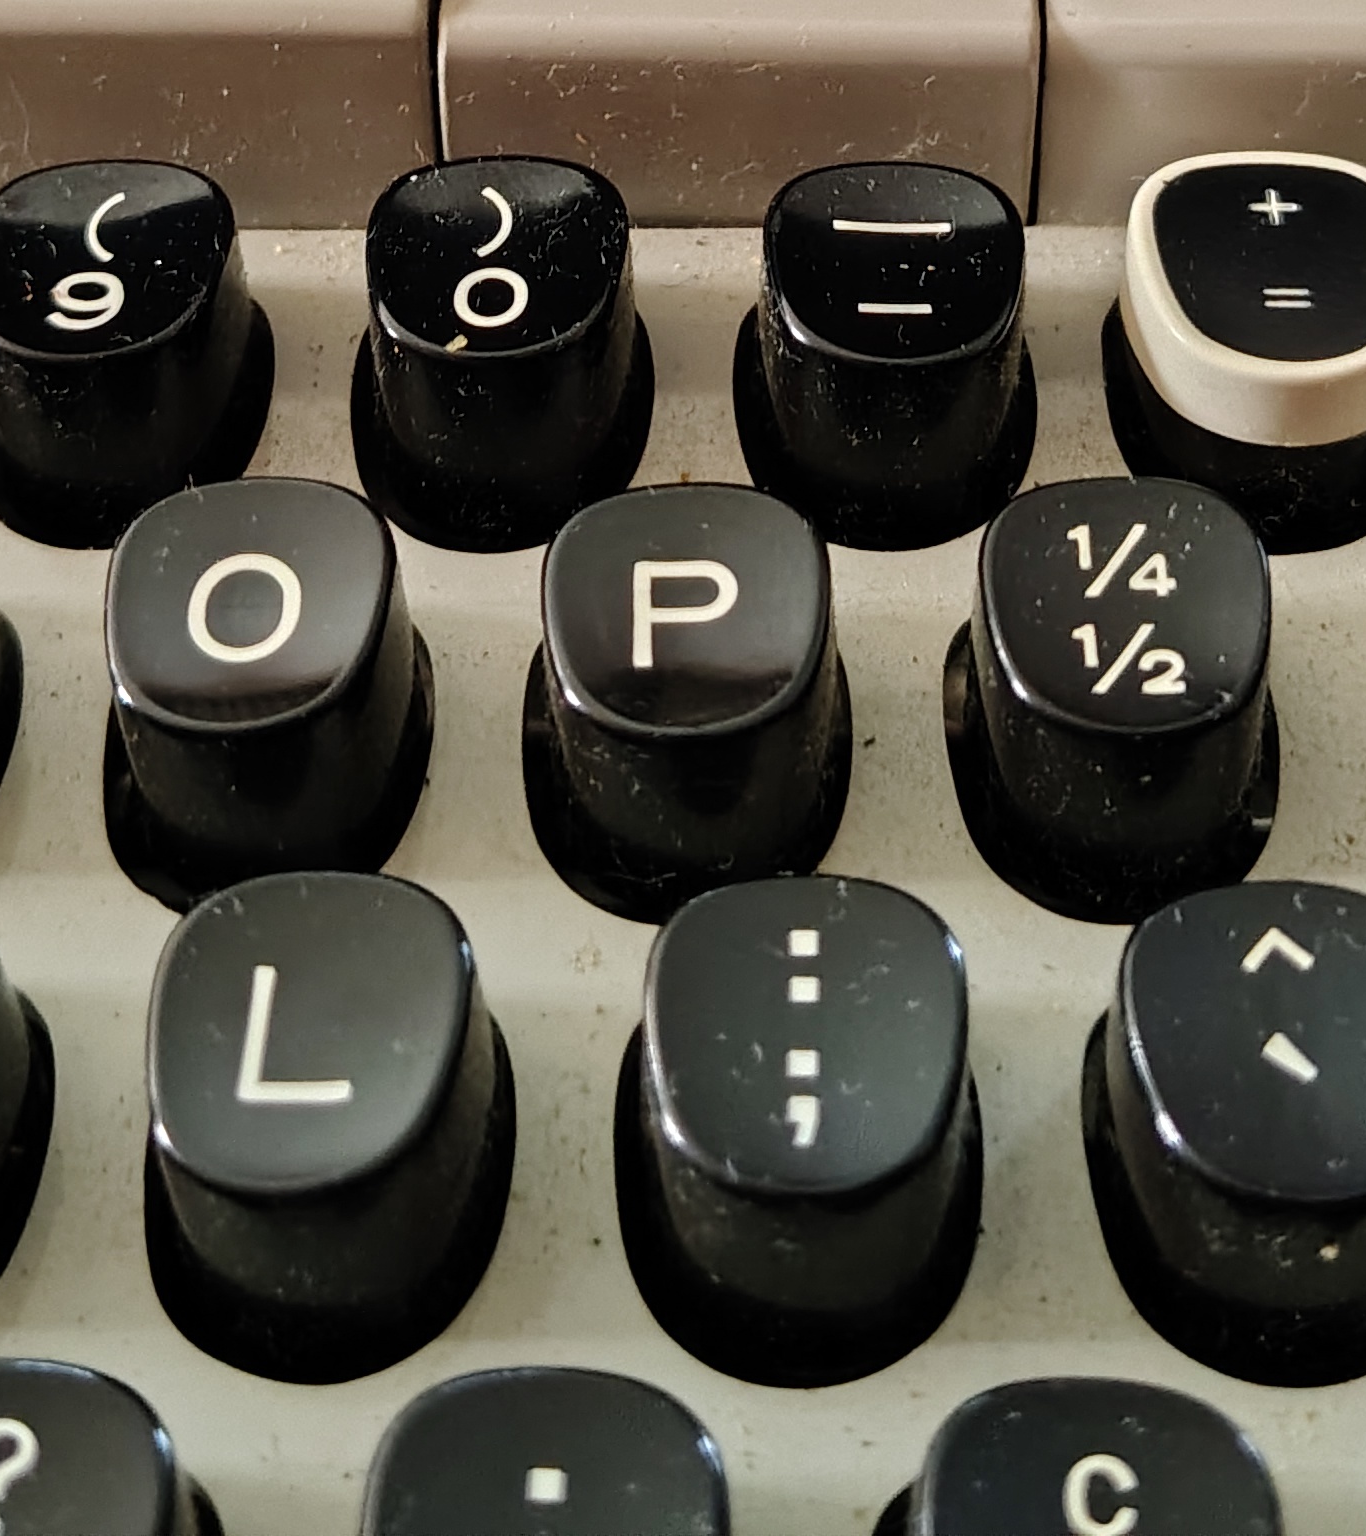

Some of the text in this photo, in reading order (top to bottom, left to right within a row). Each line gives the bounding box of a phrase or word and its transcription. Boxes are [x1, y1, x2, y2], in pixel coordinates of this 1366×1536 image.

[85, 190, 127, 263] (
[475, 185, 514, 259] )
[1249, 188, 1299, 227] +
[45, 270, 126, 332] 9
[452, 266, 530, 329] 0
[1261, 287, 1313, 309] =
[186, 552, 303, 664] O
[631, 559, 740, 669] P
[235, 964, 354, 1105] L
